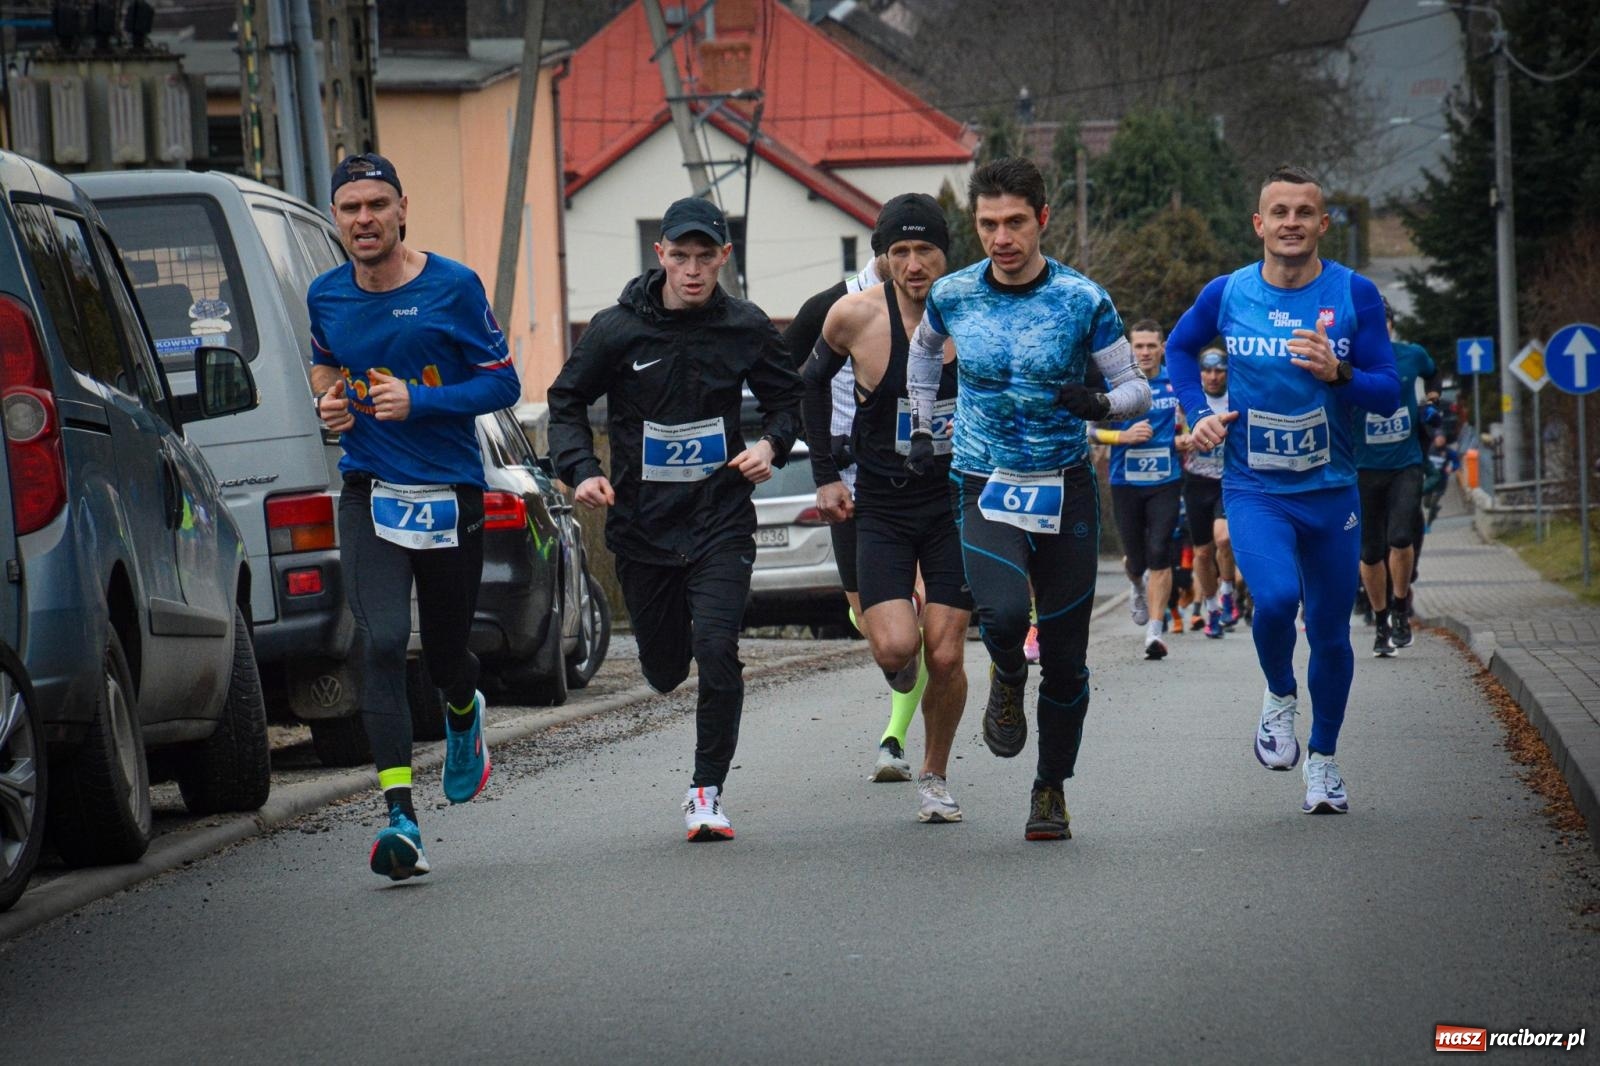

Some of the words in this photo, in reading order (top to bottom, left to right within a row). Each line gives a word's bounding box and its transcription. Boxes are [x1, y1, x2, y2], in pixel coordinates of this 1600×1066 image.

[392, 307, 418, 317] quest
[1373, 419, 1403, 435] 218
[1263, 428, 1317, 455] 114
[666, 440, 703, 465] 22
[1138, 458, 1158, 472] 92
[1003, 486, 1039, 512] 67
[397, 500, 435, 530] 74
[756, 529, 784, 542] G36
